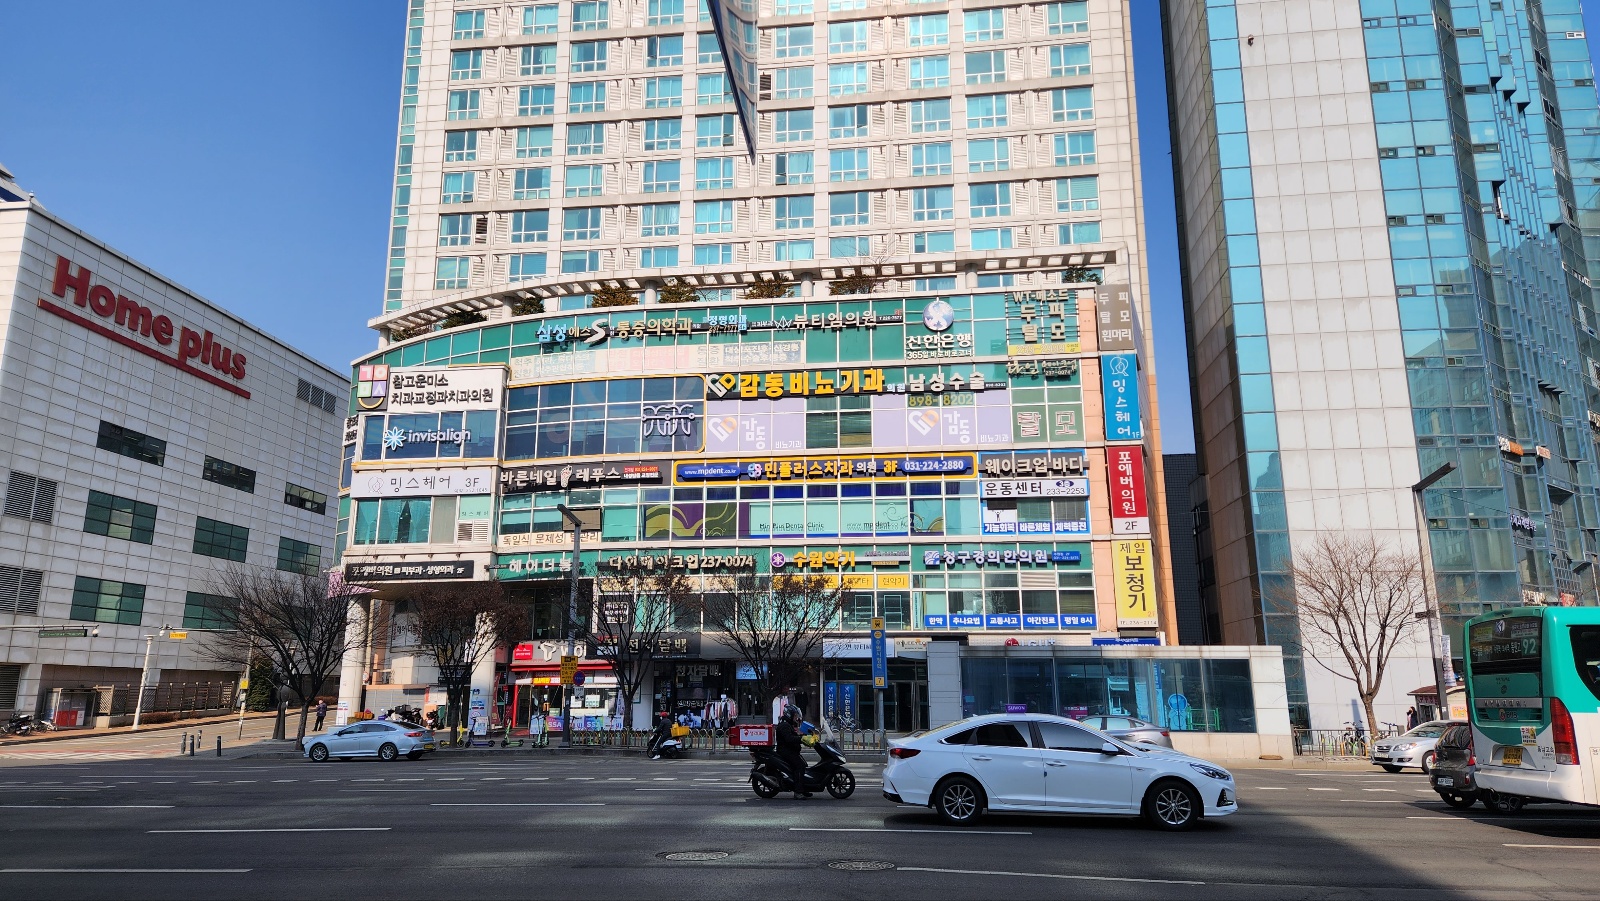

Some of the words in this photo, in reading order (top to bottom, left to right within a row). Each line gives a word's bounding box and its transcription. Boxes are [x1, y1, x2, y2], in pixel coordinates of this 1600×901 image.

[1100, 291, 1130, 305] 두피
[52, 255, 174, 345] Home
[178, 326, 247, 380] plus
[793, 310, 877, 330] 뷰티엠의원
[617, 317, 692, 340] 통증의학과
[1101, 328, 1132, 342] 흰머리
[907, 332, 973, 350] 신한은행
[907, 350, 930, 360] 365일
[393, 373, 449, 390] 참고운미소
[740, 369, 885, 399] 감동비뇨기과
[886, 383, 905, 392] 의원
[908, 371, 985, 393] 남성수술
[391, 388, 494, 407] 치과교정과치과의원
[1112, 378, 1132, 436] 밍스헤어
[408, 427, 473, 445] invisalign
[741, 417, 766, 450] 감동
[943, 410, 971, 444] 감동
[775, 440, 803, 449] 비뇨기과
[980, 434, 1009, 443] 비뇨기과
[684, 466, 737, 476] www.mpdent.co.kr
[764, 461, 853, 479] 민플러스치과
[857, 461, 877, 473] 의원
[883, 461, 898, 473] 3F
[904, 459, 964, 471] 031-224-2880
[985, 457, 1047, 476] 웨이크업
[1053, 455, 1083, 475] 바디
[390, 475, 451, 493] 밍스헤어
[465, 477, 481, 488] 3F
[501, 468, 558, 487] 바른네일
[575, 466, 622, 482] 레푸스
[1117, 450, 1136, 515] 포에버의원
[984, 481, 1042, 496] 운동센터
[1046, 487, 1085, 496] 233-2253
[1125, 520, 1139, 531] 2F
[503, 535, 530, 546] 독일식
[536, 533, 564, 544] 문제성
[1119, 542, 1146, 554] 제일
[700, 555, 754, 569] 237-0074
[793, 551, 856, 569] 수원악기
[942, 548, 1048, 565] 청구경희한의원
[1125, 555, 1147, 612] 보청기
[928, 616, 943, 625] 한약
[952, 616, 981, 625] 추나요법
[1027, 616, 1056, 625] 야간진료
[1080, 615, 1093, 625] 8시
[1523, 639, 1537, 654] 92
